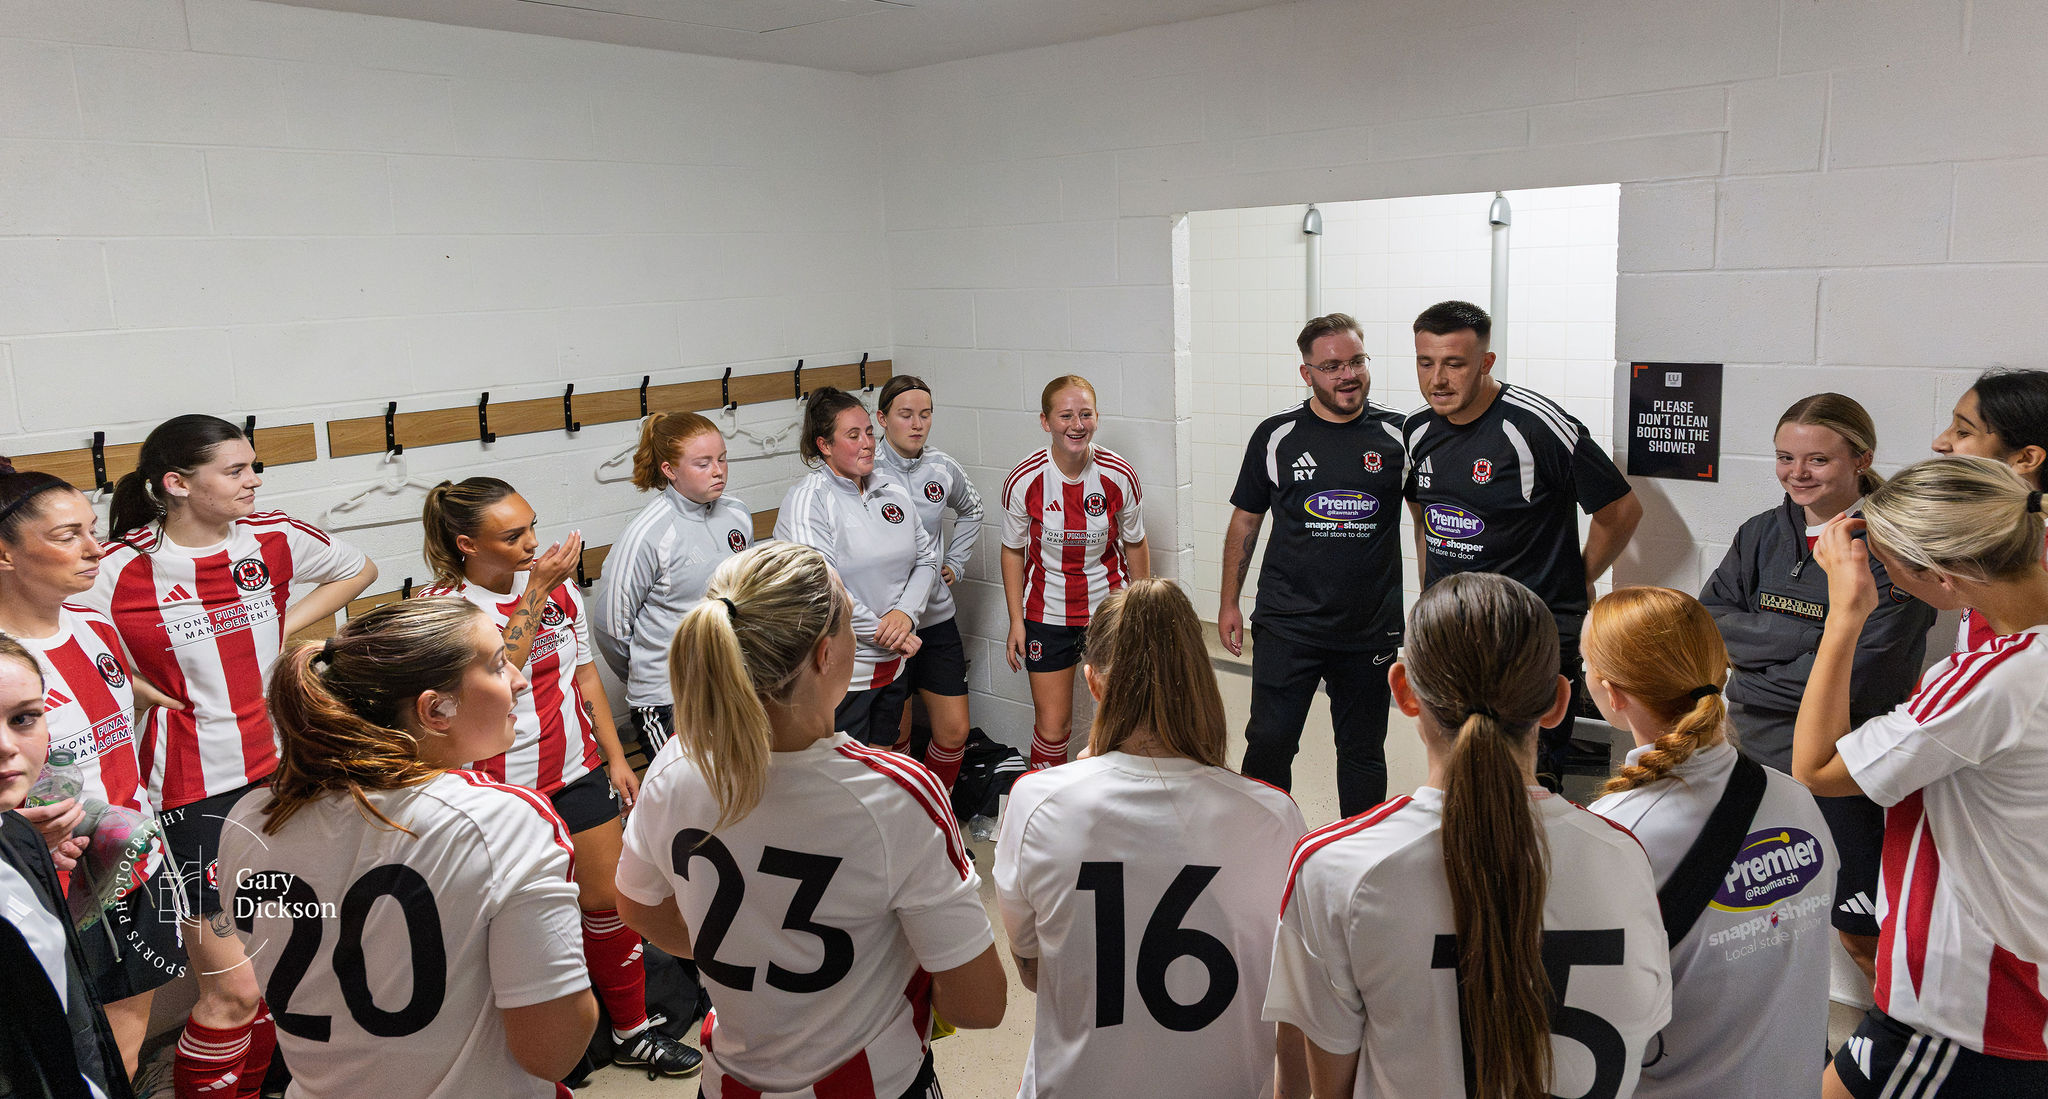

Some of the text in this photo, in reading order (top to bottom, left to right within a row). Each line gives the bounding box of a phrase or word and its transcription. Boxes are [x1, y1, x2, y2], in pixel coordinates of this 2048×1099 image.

[1653, 400, 1694, 413] PLEASE
[1638, 413, 1708, 427] DON'T CLEAN
[1637, 427, 1710, 441] BOOTS IN THE
[1648, 440, 1696, 454] SHOWER
[1294, 469, 1316, 481] RY
[1418, 475, 1431, 489] BS
[1318, 496, 1376, 511] Premier
[1305, 521, 1377, 531] snappy shopper
[1430, 508, 1480, 530] Premier
[1446, 539, 1483, 552] shopper
[1457, 552, 1475, 560] door
[166, 598, 275, 634] LYONS FINANCIAL
[185, 610, 269, 640] MANAGEMENT
[97, 711, 133, 738] FINAN
[1724, 837, 1818, 894] Premier
[671, 827, 855, 994] 23
[1708, 914, 1772, 946] snappy
[233, 863, 447, 1043] 20
[1075, 861, 1239, 1032] 16
[1725, 939, 1757, 961] Local
[1431, 928, 1627, 1099] 15
